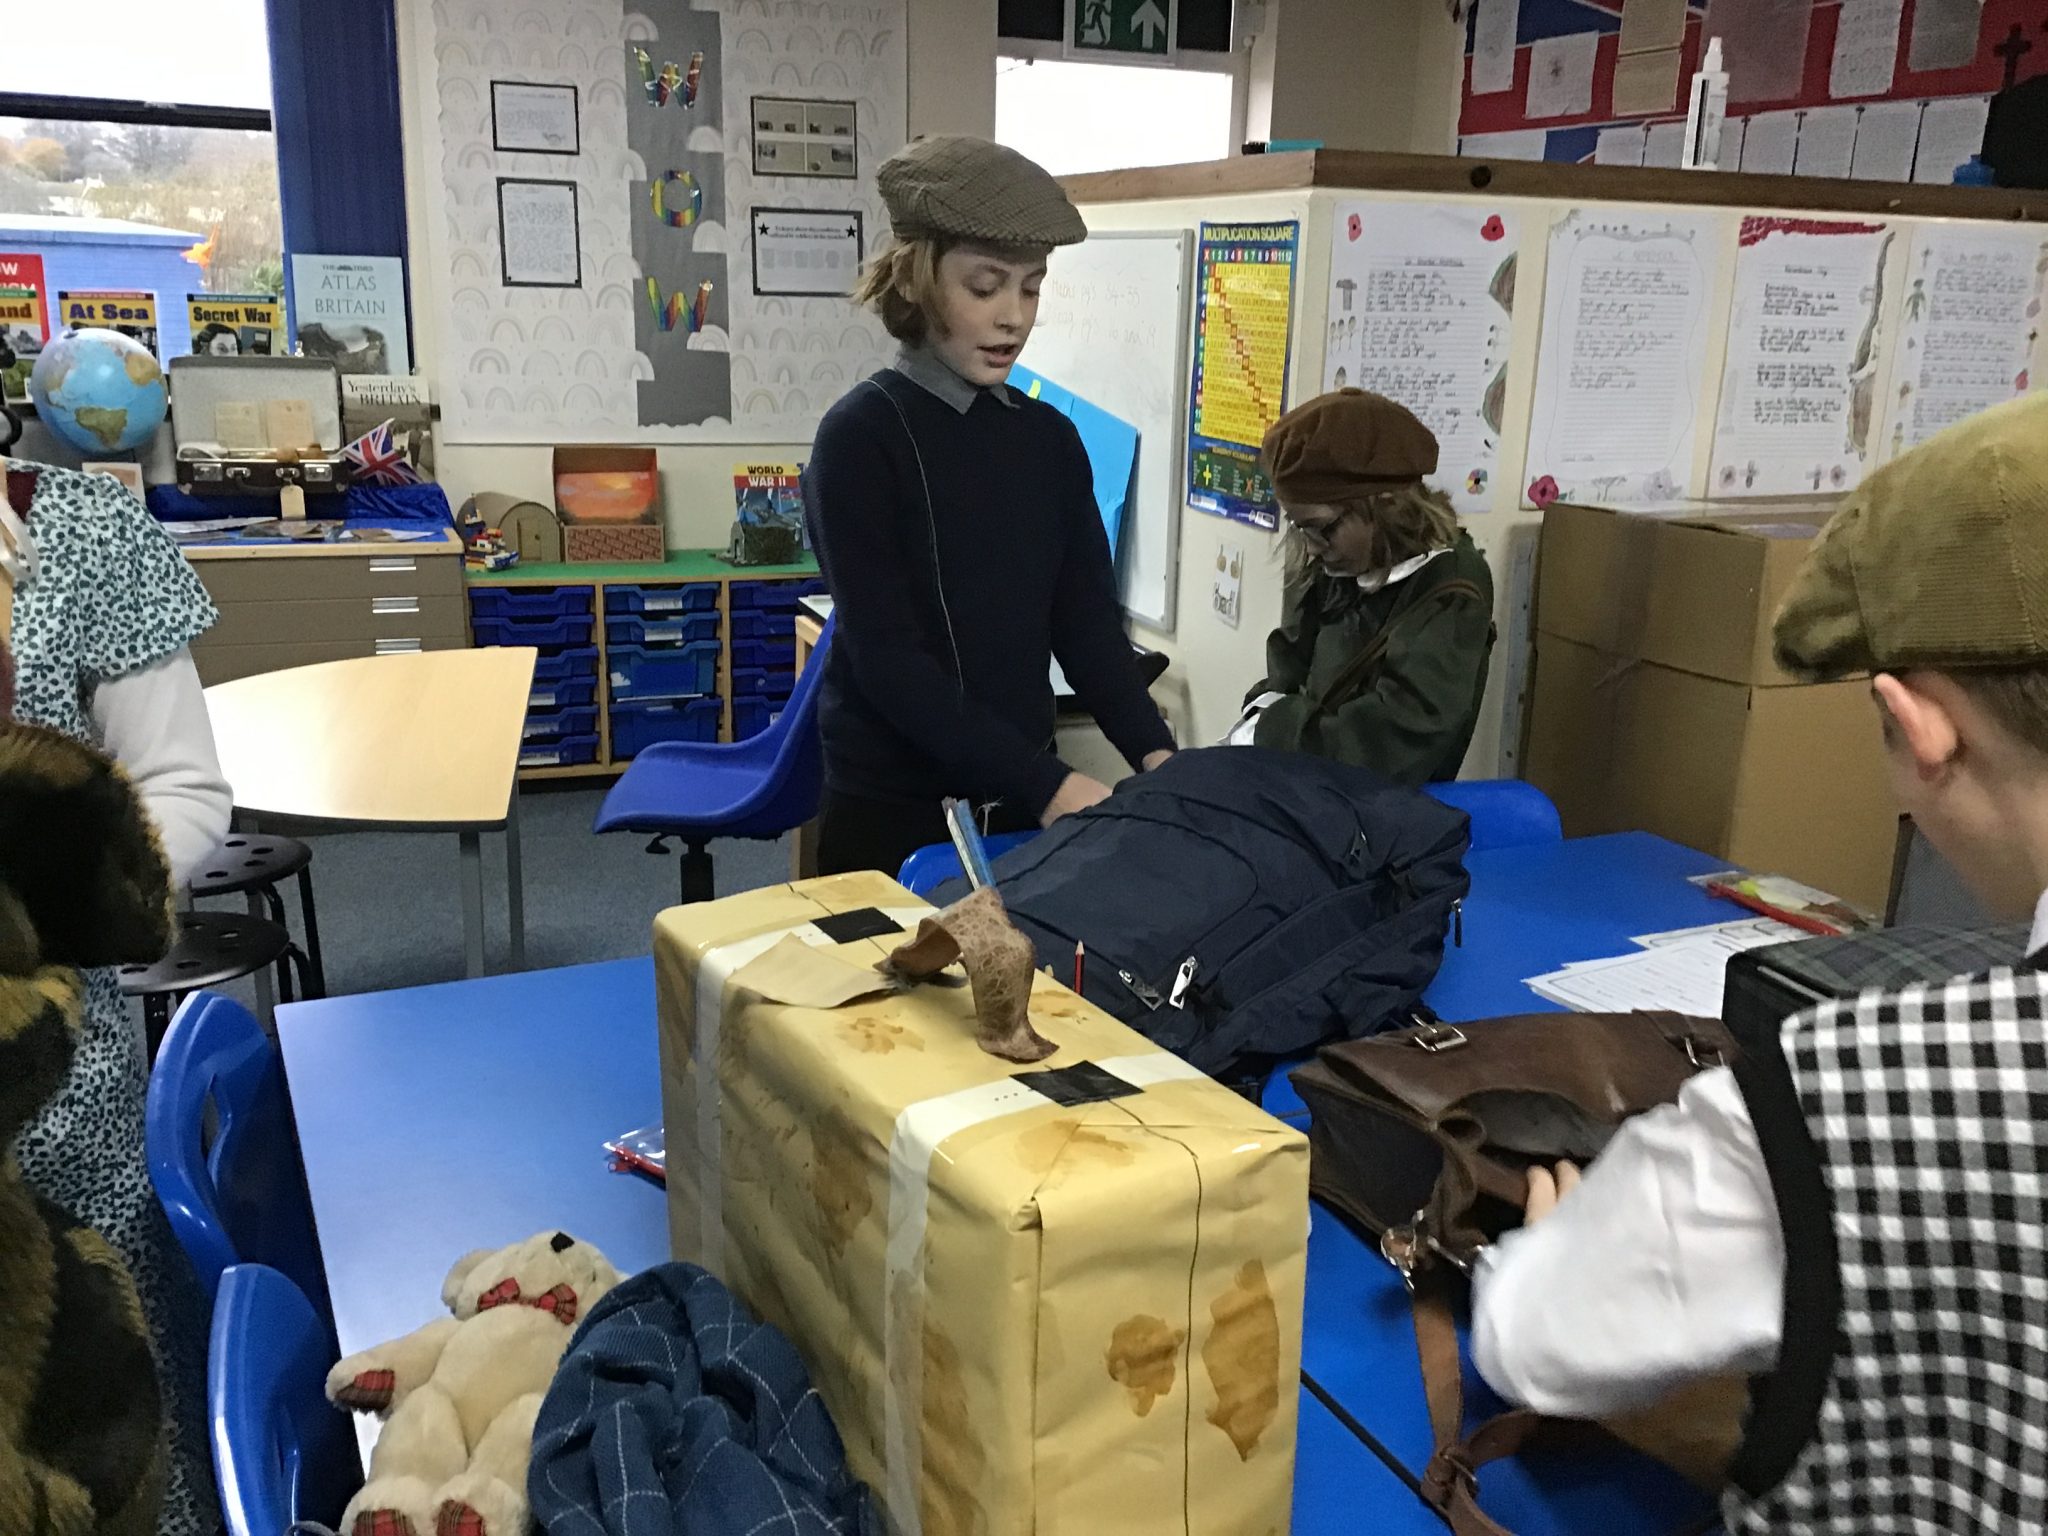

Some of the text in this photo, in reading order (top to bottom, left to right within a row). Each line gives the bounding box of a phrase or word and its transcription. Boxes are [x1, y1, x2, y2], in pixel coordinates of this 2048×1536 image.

[1203, 225, 1295, 241] MULTIPLICATION SQUARE
[0, 262, 18, 275] W
[321, 275, 377, 291] ATLAS
[69, 303, 149, 320] At Sea
[315, 298, 385, 314] BRITAIN
[193, 306, 272, 323] Secret War
[348, 380, 416, 393] Yesterday's
[360, 393, 421, 406] BRITAIN
[747, 465, 784, 475] WORLD
[748, 476, 786, 487] WAR II
